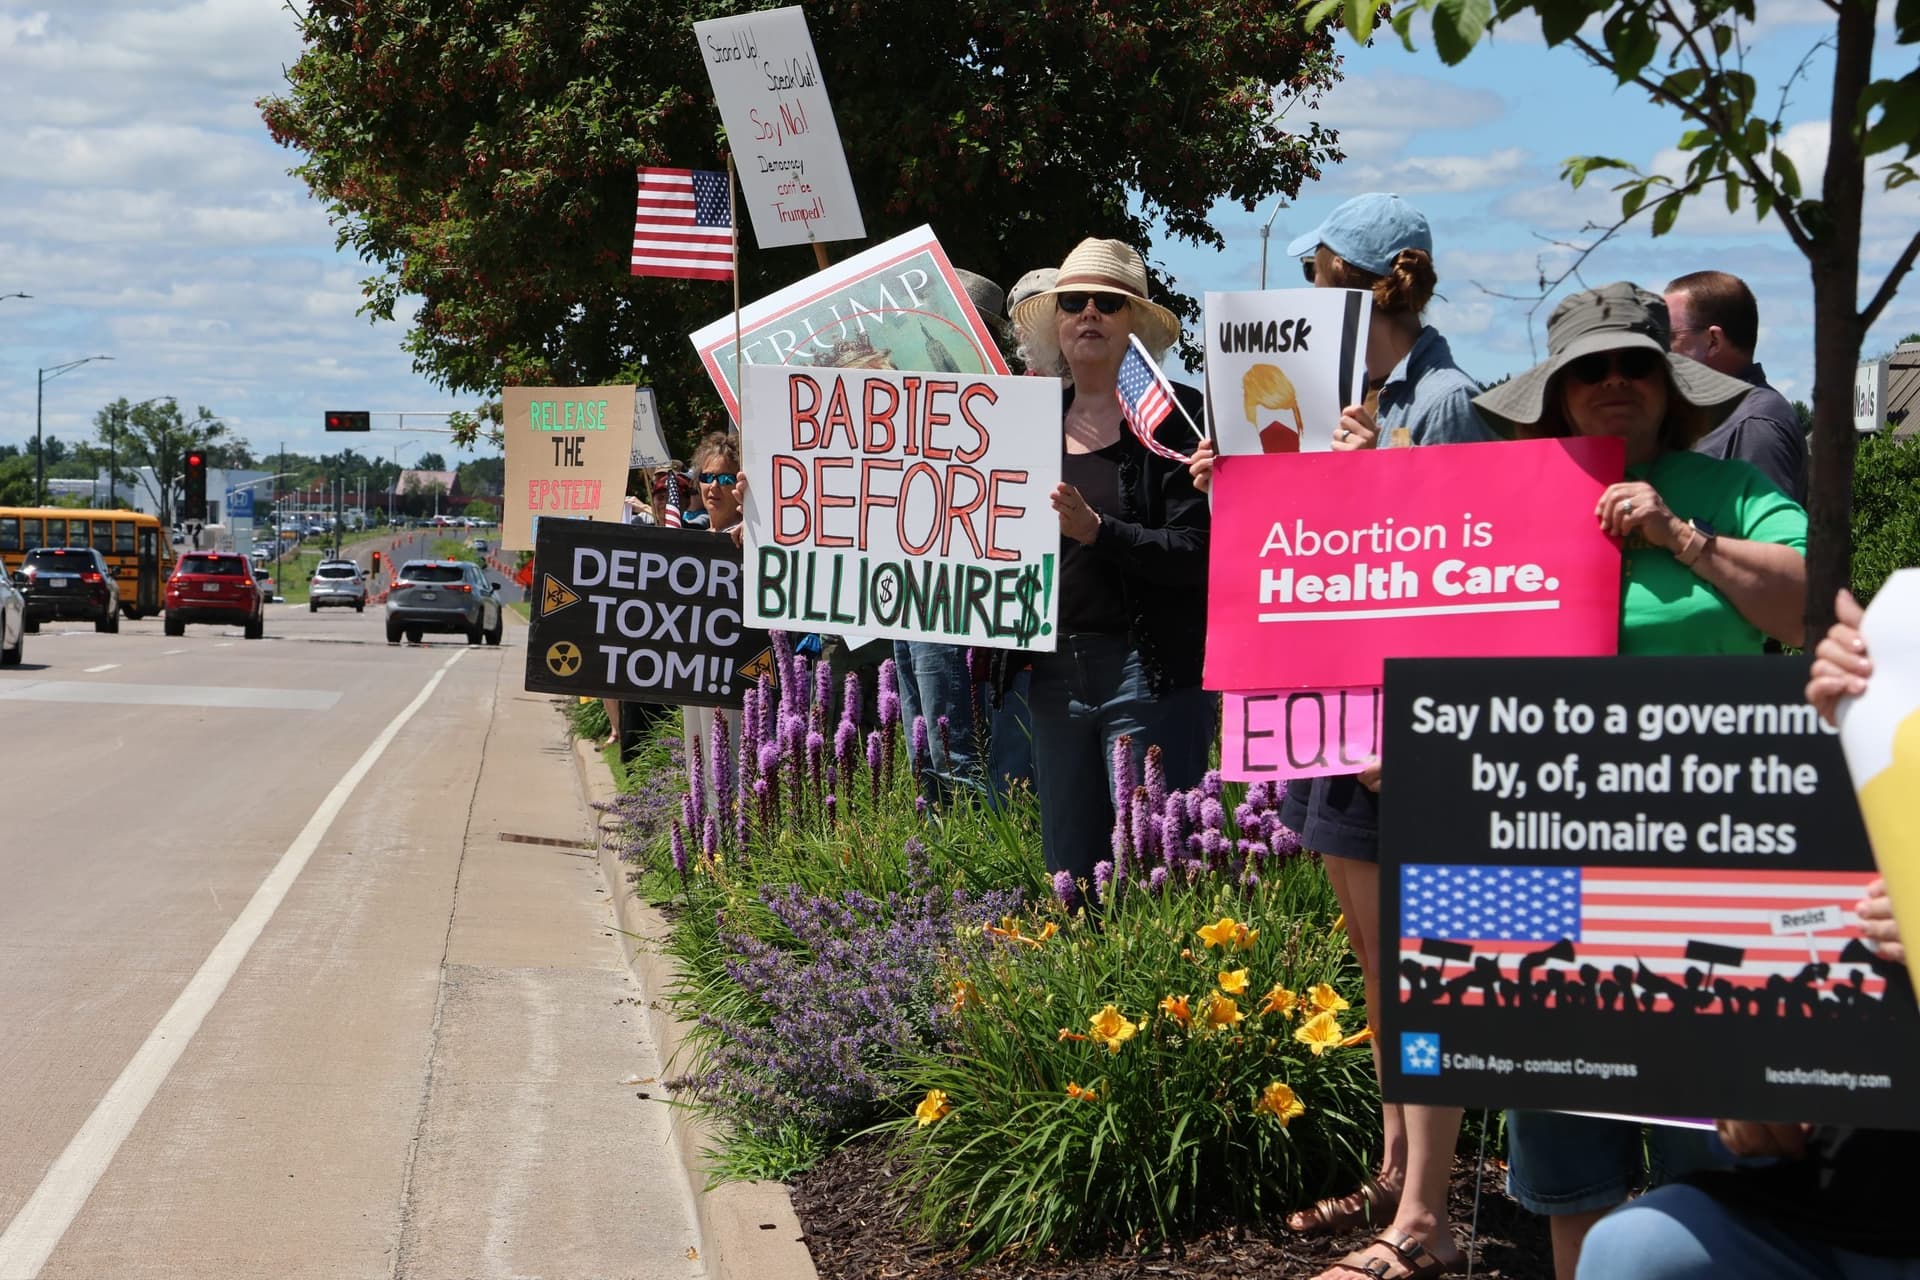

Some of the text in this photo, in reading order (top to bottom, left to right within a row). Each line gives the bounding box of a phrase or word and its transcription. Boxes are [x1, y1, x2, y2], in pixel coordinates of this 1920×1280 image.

[763, 51, 818, 101] Speak Out!
[750, 98, 810, 147] Say No!
[757, 155, 804, 176] Democracy
[770, 196, 826, 230] Trumped!
[727, 268, 928, 366] TRUMP
[1220, 318, 1312, 353] UNMASK
[530, 400, 608, 431] RELEASE
[789, 374, 999, 464] BABIES
[551, 436, 585, 467] THE
[528, 479, 602, 510] EPSTEIN
[772, 454, 1029, 562] BEFORE
[1258, 512, 1494, 558] Abortion is
[573, 547, 744, 600] DEPOR
[1258, 559, 1560, 604] Health Care.
[588, 595, 741, 647] TOXIC
[599, 645, 734, 695] TOM!!
[1411, 697, 1479, 740] Say
[1489, 697, 1544, 735] No
[1553, 698, 1595, 735] to
[1603, 705, 1628, 735] a
[1472, 753, 1819, 799] by, of, and for the
[1490, 811, 1798, 854] billionaire class
[1781, 910, 1826, 928] Resist
[1453, 1053, 1485, 1071] Calls
[1487, 1055, 1514, 1074] App
[1524, 1058, 1572, 1075] contact
[1574, 1058, 1638, 1080] Congress
